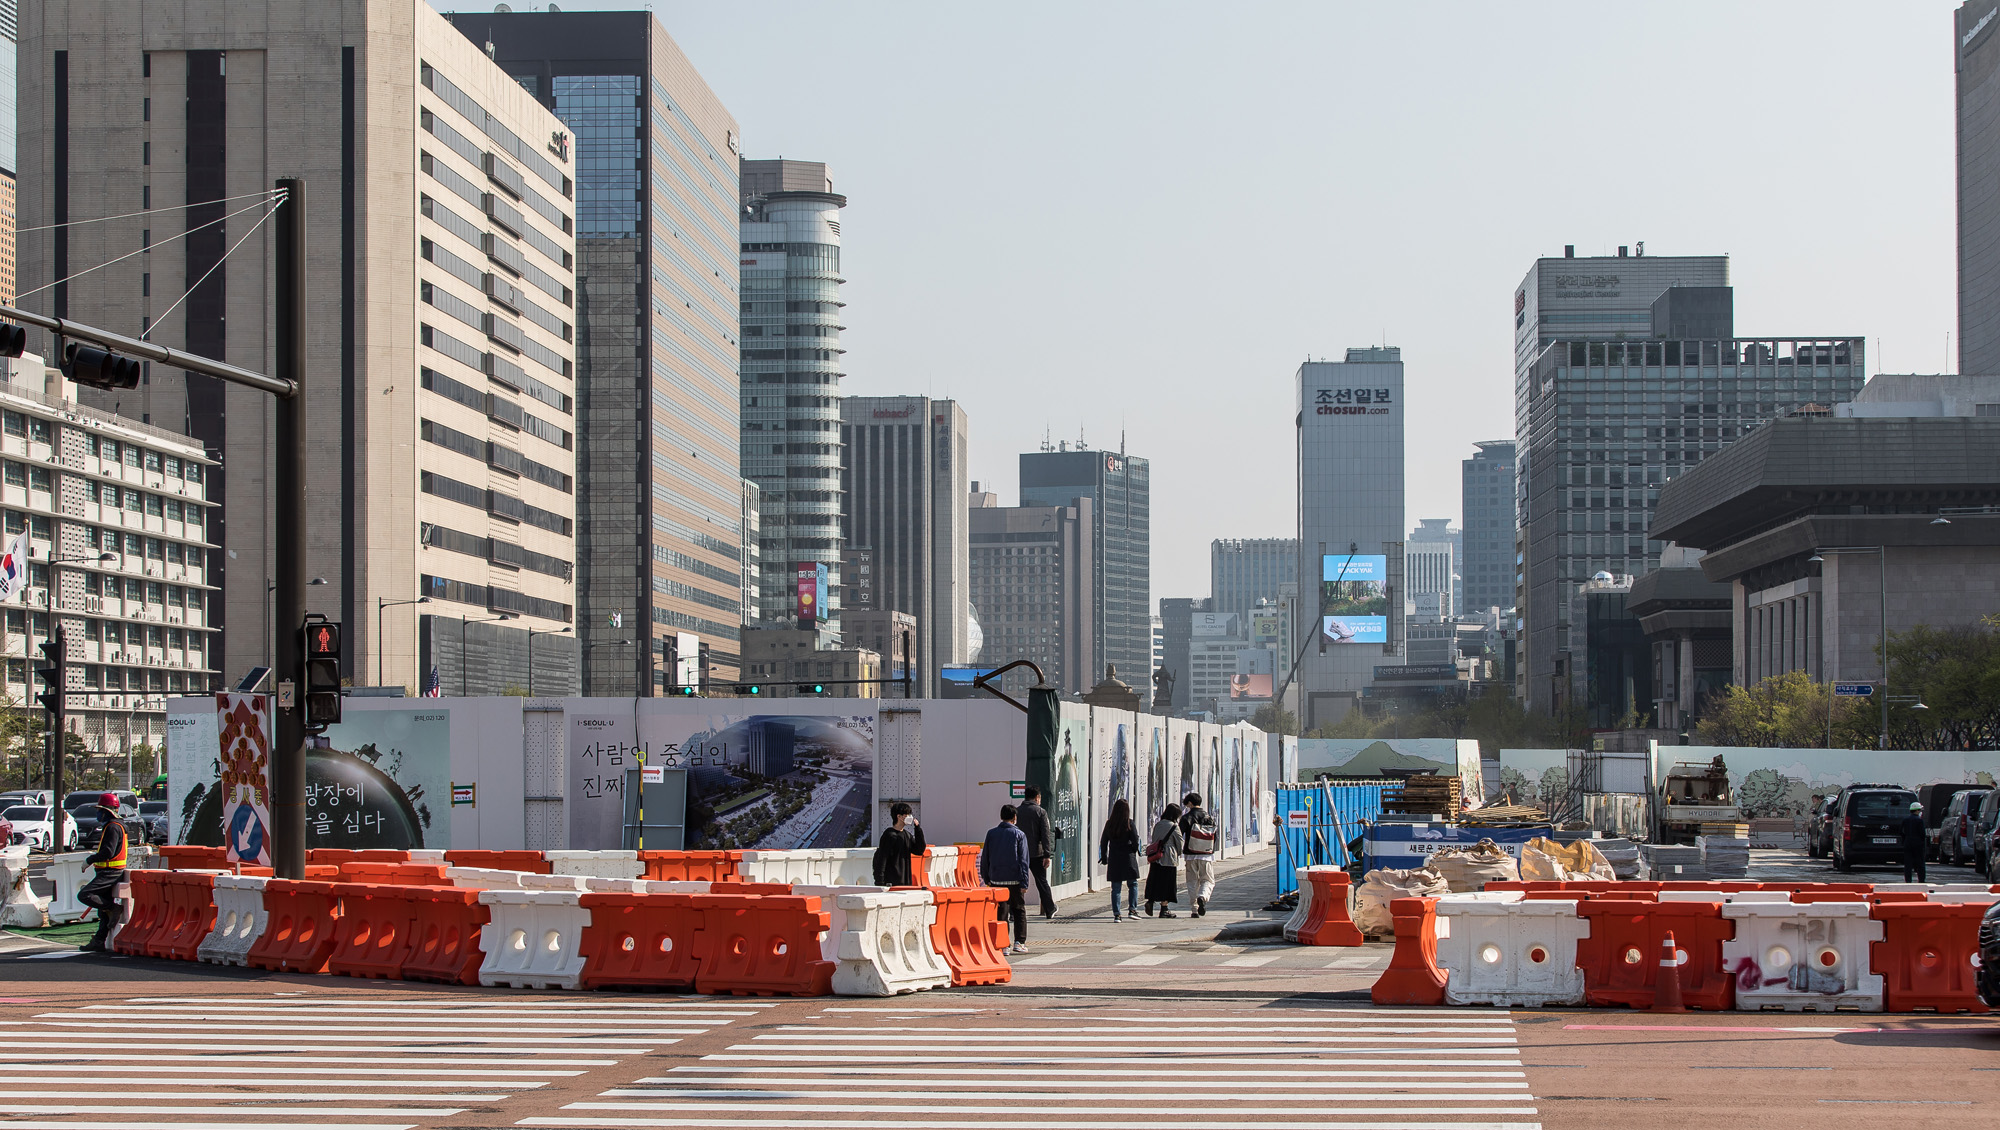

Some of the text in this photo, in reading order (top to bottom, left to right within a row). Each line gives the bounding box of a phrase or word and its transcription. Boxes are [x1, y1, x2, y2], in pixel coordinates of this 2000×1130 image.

[1556, 274, 1620, 289] 감리교본부
[1556, 291, 1594, 299] Methodist
[1315, 388, 1392, 404] 조선일보
[873, 408, 909, 419] kobaco
[1316, 404, 1389, 415] chosun.com
[581, 741, 728, 767] 사람이 중심인
[305, 782, 364, 807] 광장에
[582, 774, 625, 800] 진짜
[229, 786, 262, 807] 공사중
[342, 810, 386, 834] 심다
[1409, 844, 1434, 854] 새로운
